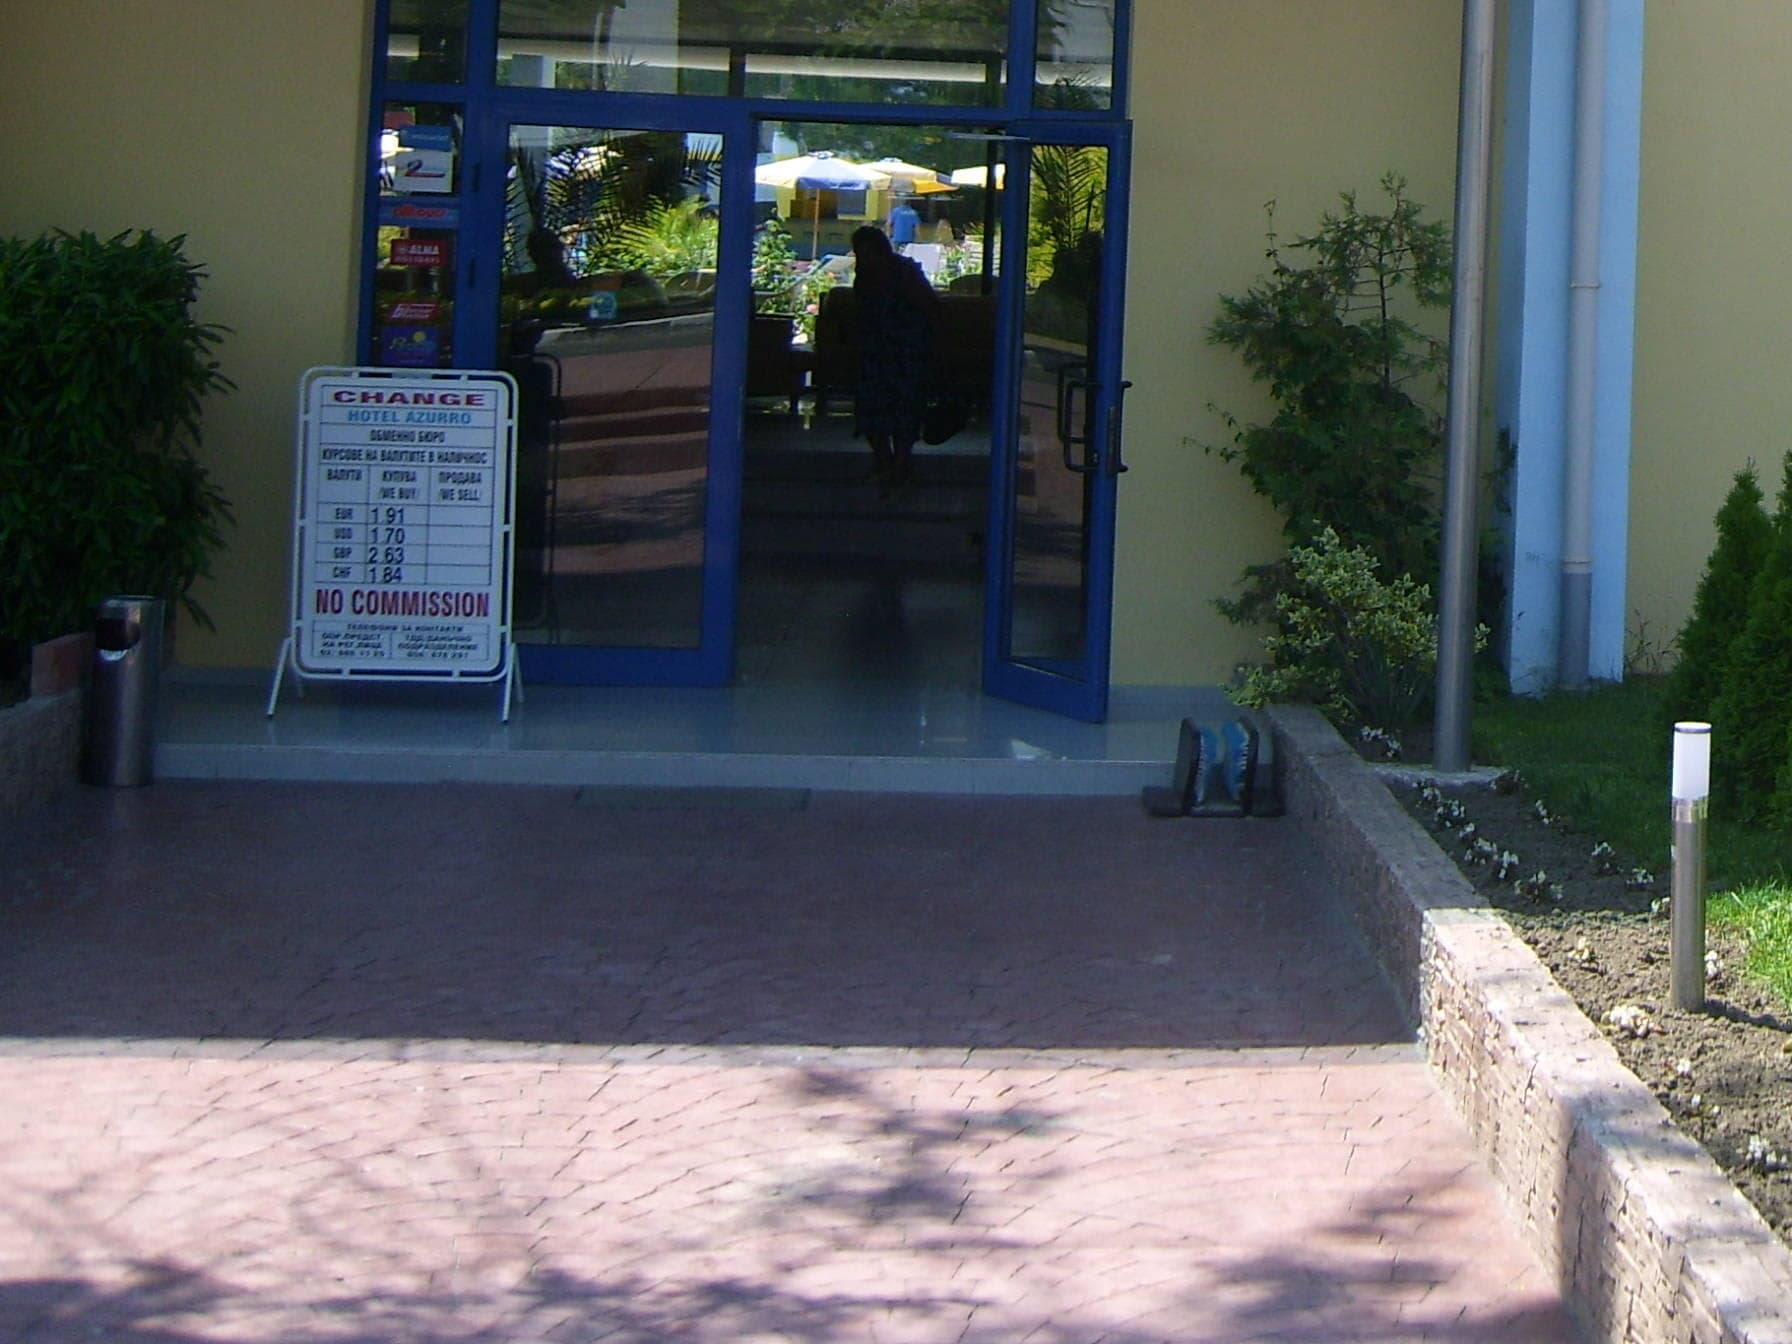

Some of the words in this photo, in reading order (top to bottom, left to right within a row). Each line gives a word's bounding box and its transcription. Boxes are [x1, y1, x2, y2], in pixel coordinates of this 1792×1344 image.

[334, 390, 485, 406] CHANGE
[348, 410, 400, 423] HOTEL
[406, 411, 472, 425] AZURRO
[315, 588, 344, 614] NO
[351, 589, 489, 618] COMMISSION
